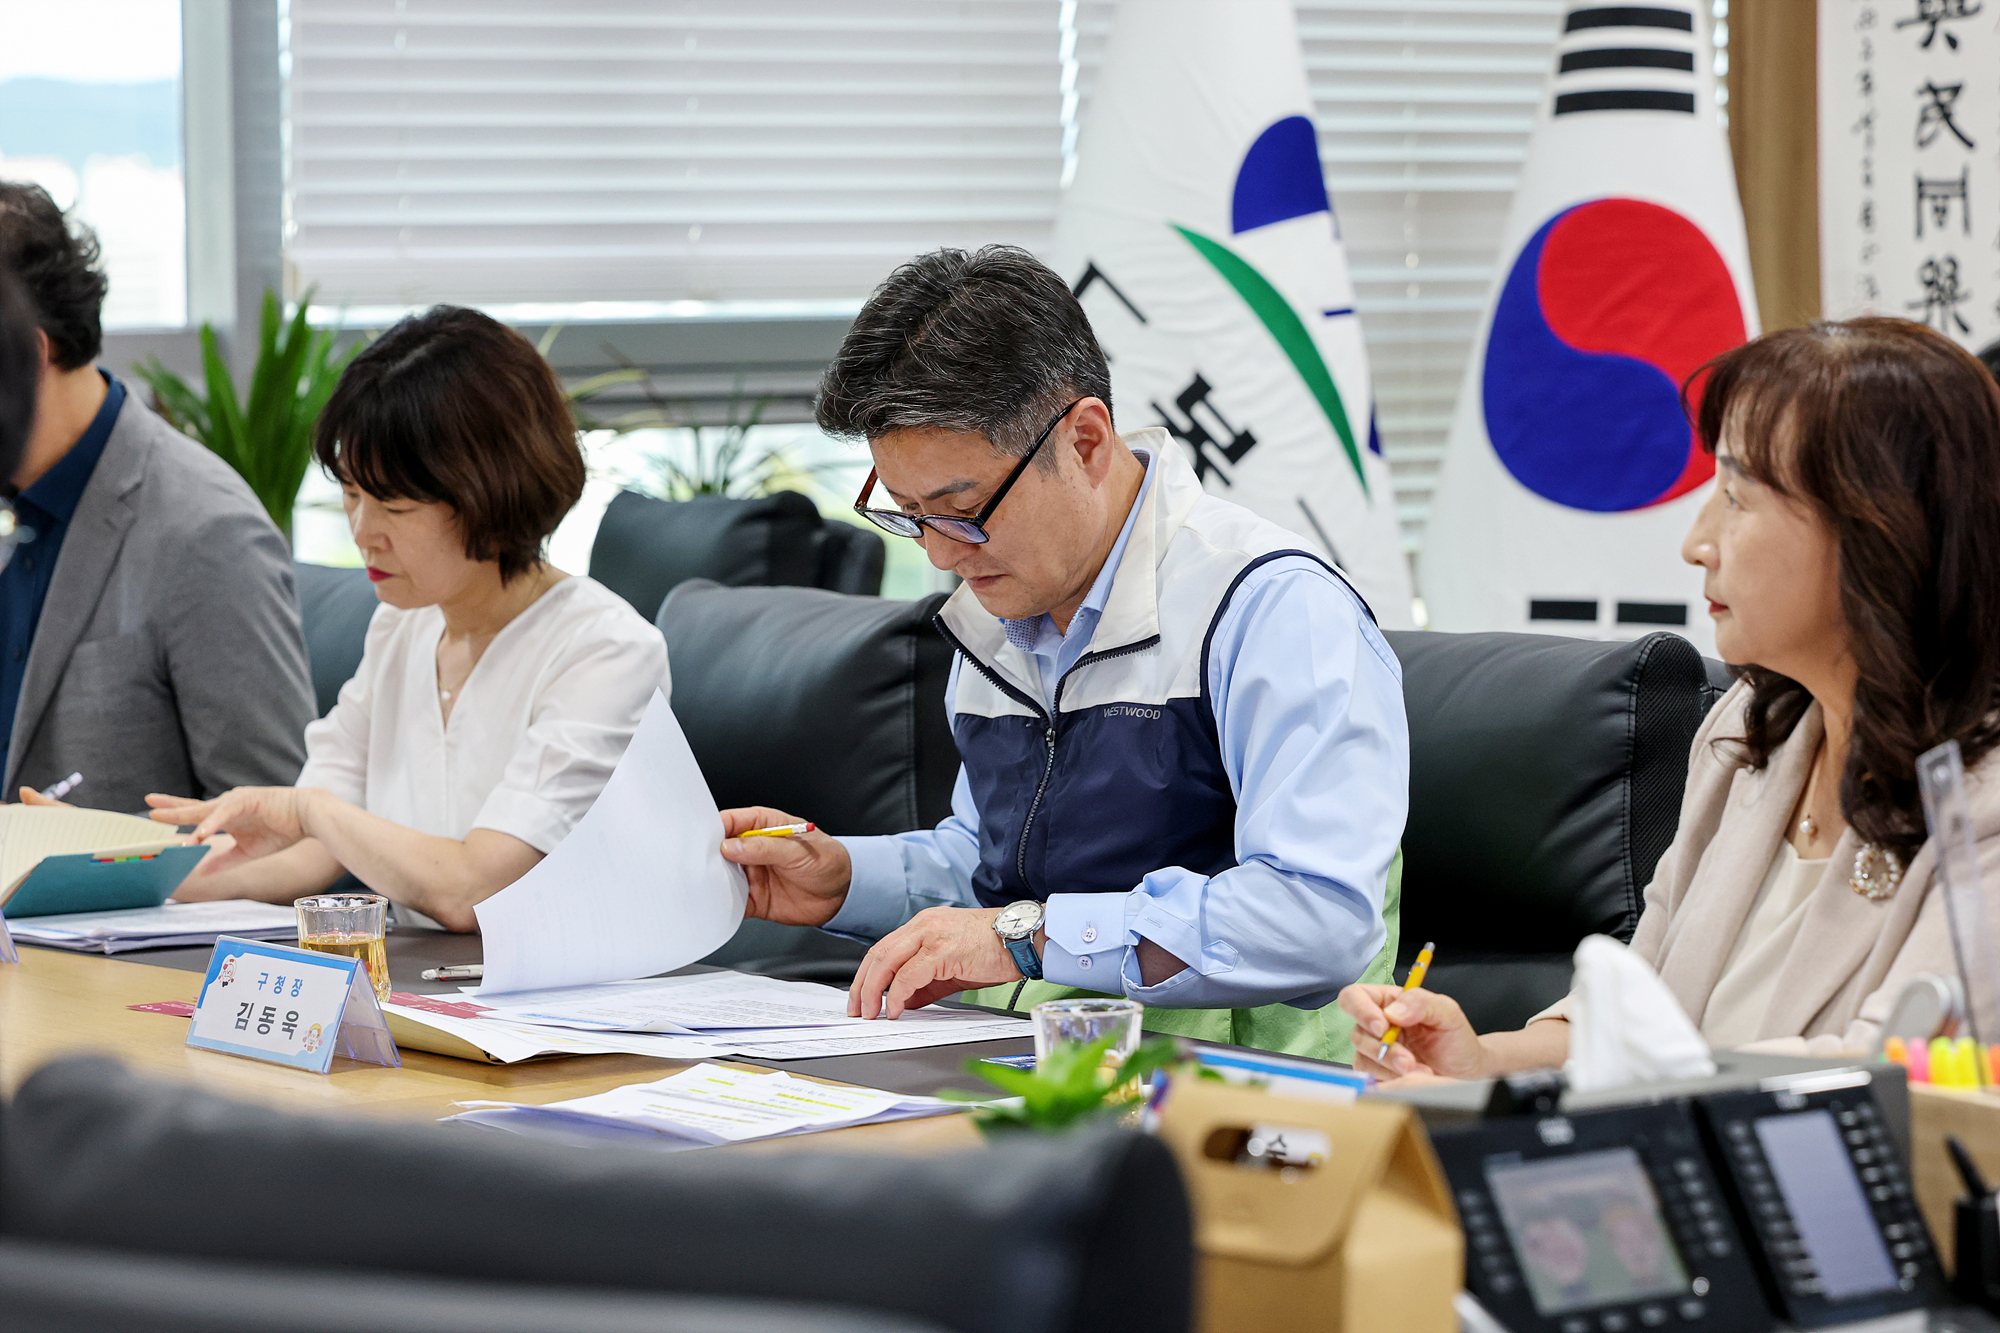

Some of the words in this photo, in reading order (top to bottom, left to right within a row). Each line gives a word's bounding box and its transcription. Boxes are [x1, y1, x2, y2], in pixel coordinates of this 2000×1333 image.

[1103, 706, 1161, 720] WESTWOOD
[257, 972, 304, 998] 구청장
[234, 1002, 300, 1040] 김동욱
